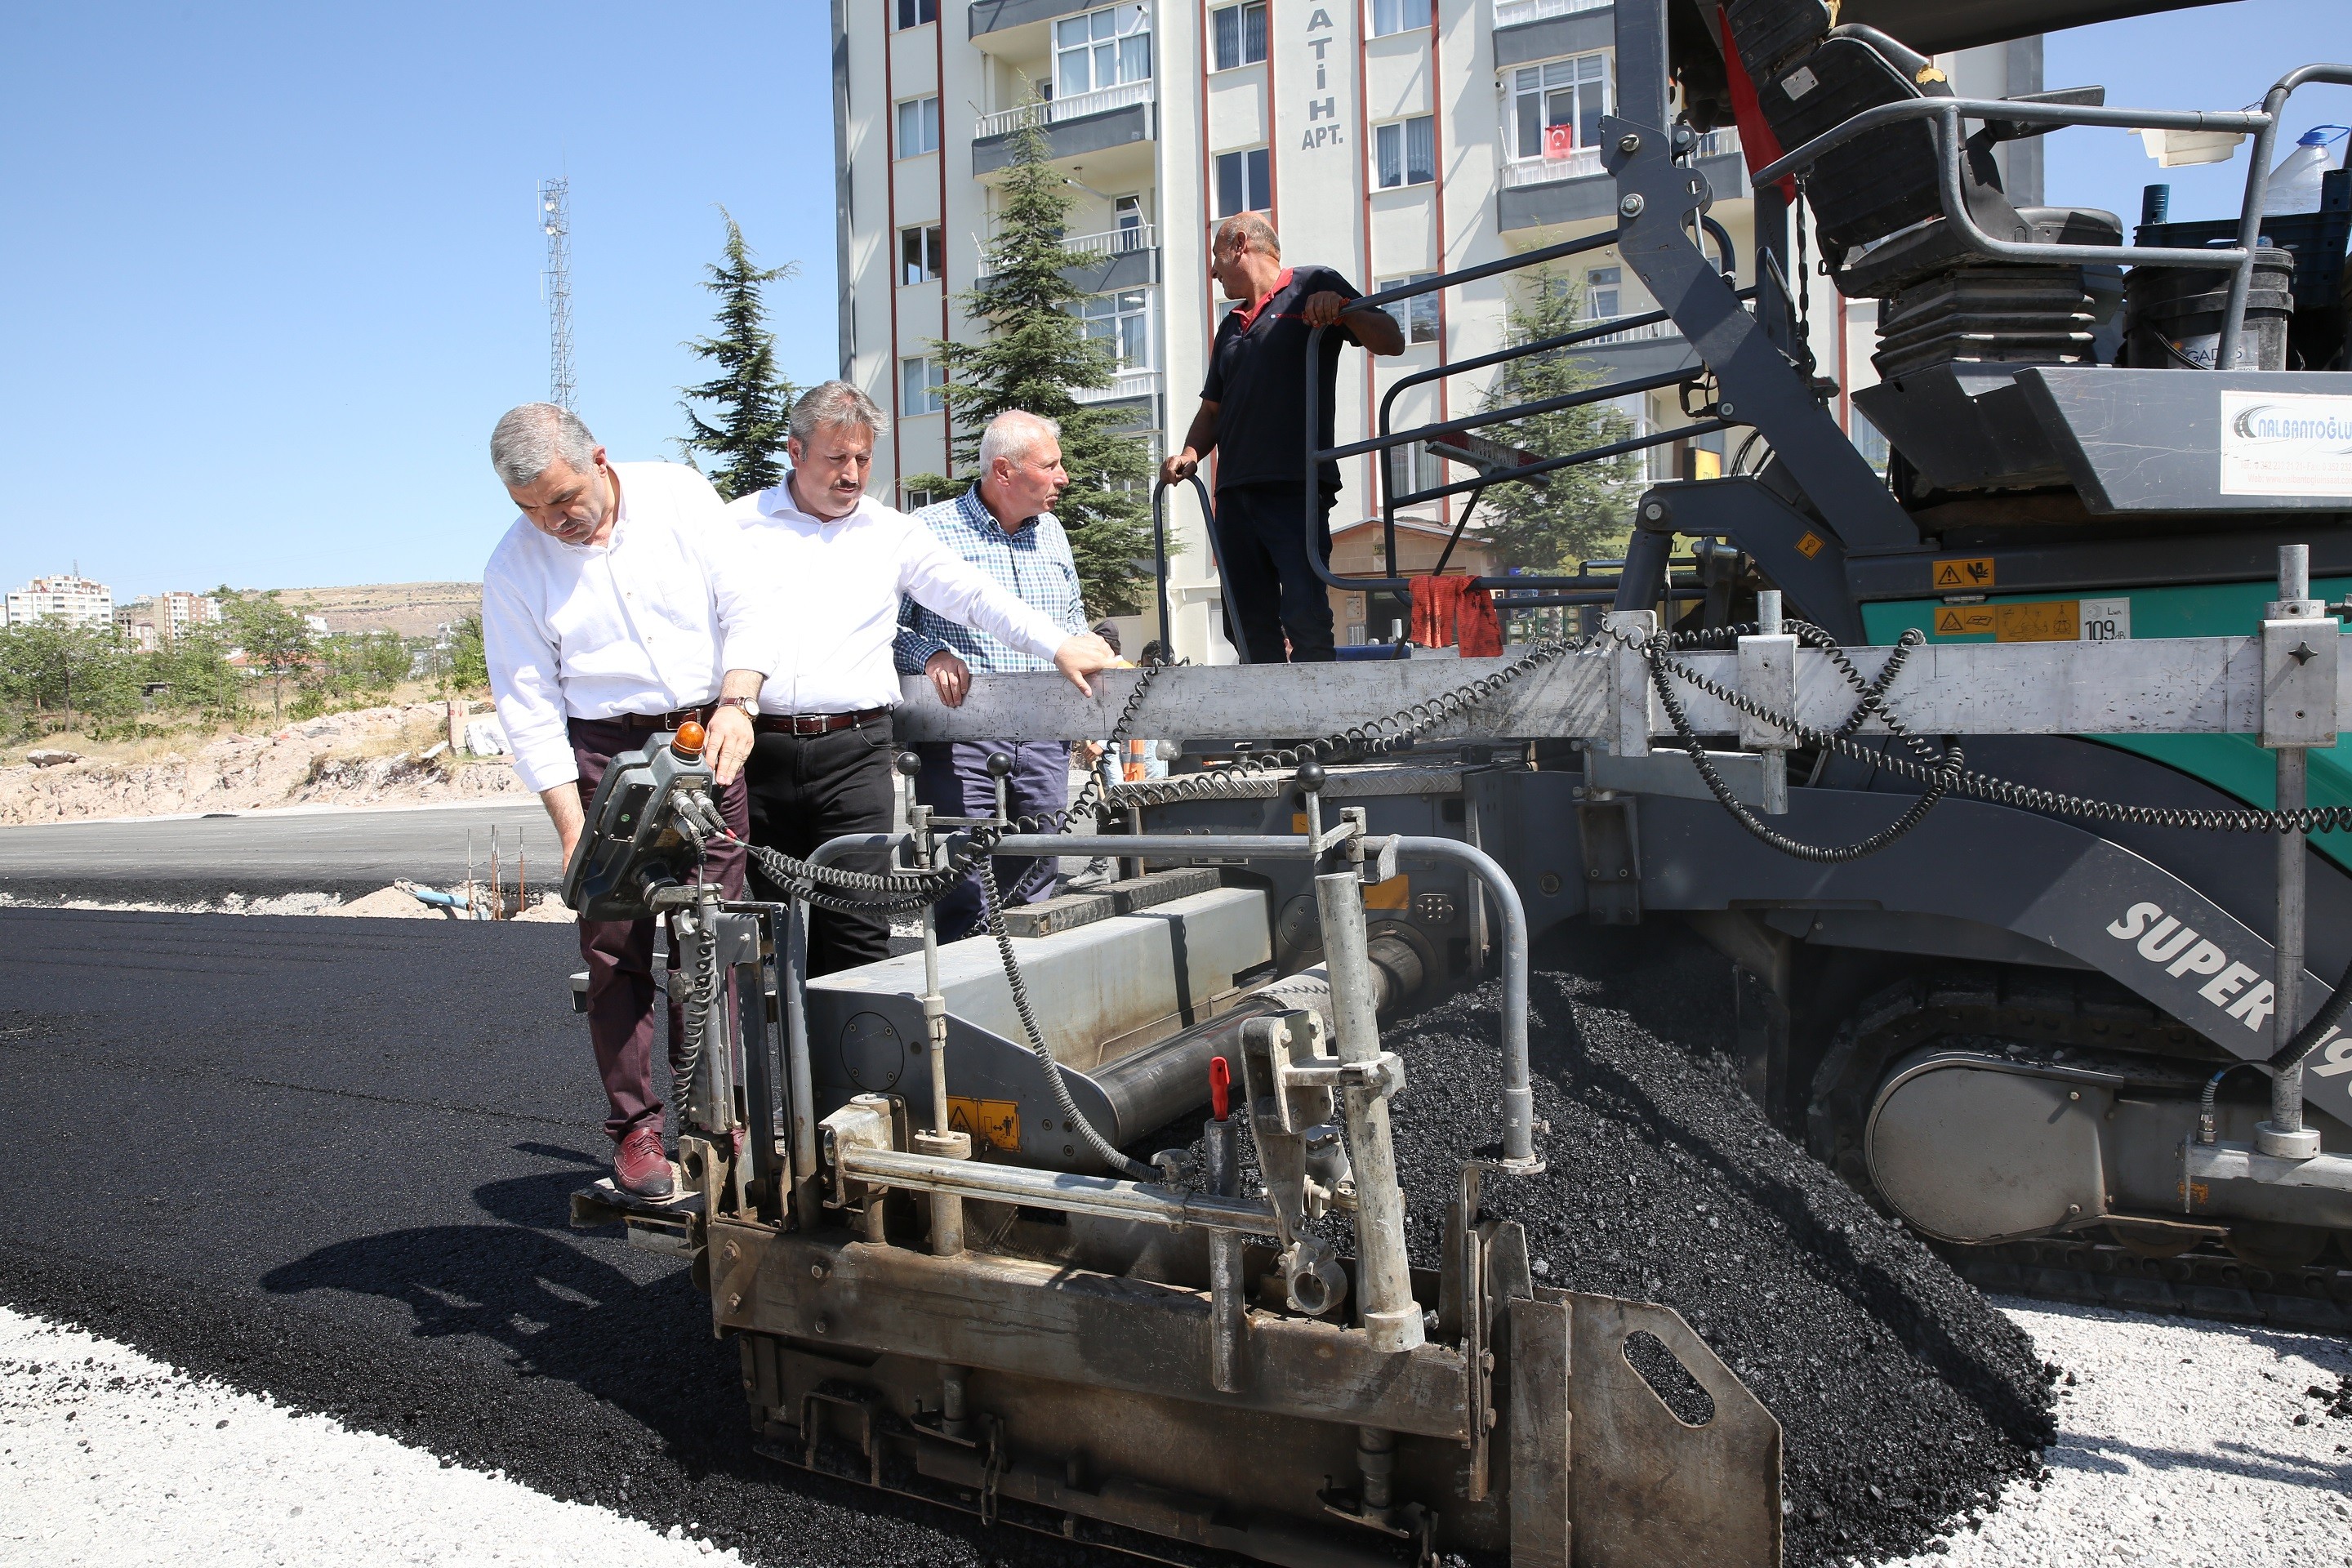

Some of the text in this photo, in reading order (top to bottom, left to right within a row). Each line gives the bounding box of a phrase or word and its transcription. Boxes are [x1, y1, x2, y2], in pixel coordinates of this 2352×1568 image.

[1307, 0, 1334, 121] ATİH
[1301, 124, 1343, 151] APT.
[2247, 474, 2265, 483] Web:
[2328, 463, 2339, 471] 352
[2085, 620, 2115, 640] 109
[2106, 902, 2274, 1032] SUPER
